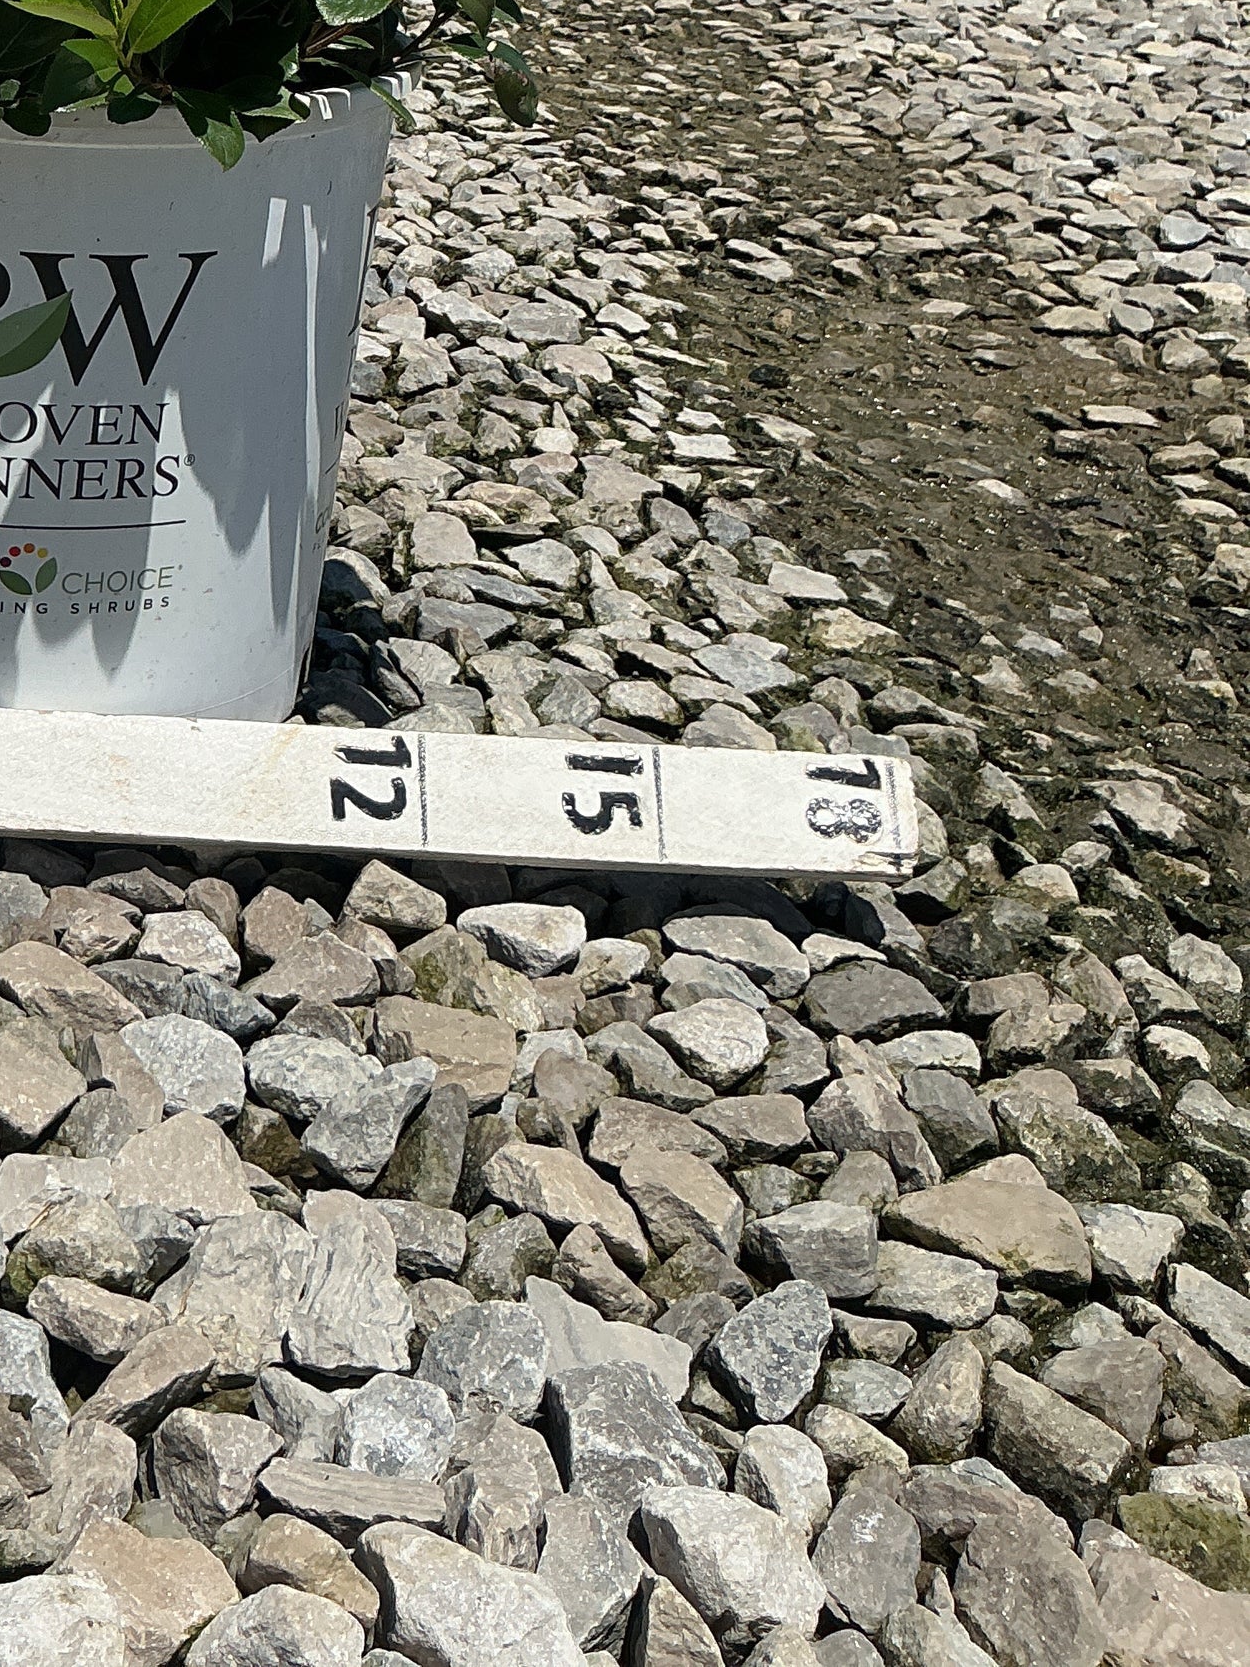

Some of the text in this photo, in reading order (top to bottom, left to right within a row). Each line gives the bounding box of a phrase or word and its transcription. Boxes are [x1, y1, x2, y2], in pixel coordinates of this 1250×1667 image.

[69, 596, 170, 615] SHRUBS
[329, 735, 413, 822] 12
[561, 746, 645, 836] 15
[804, 758, 883, 845] 18
